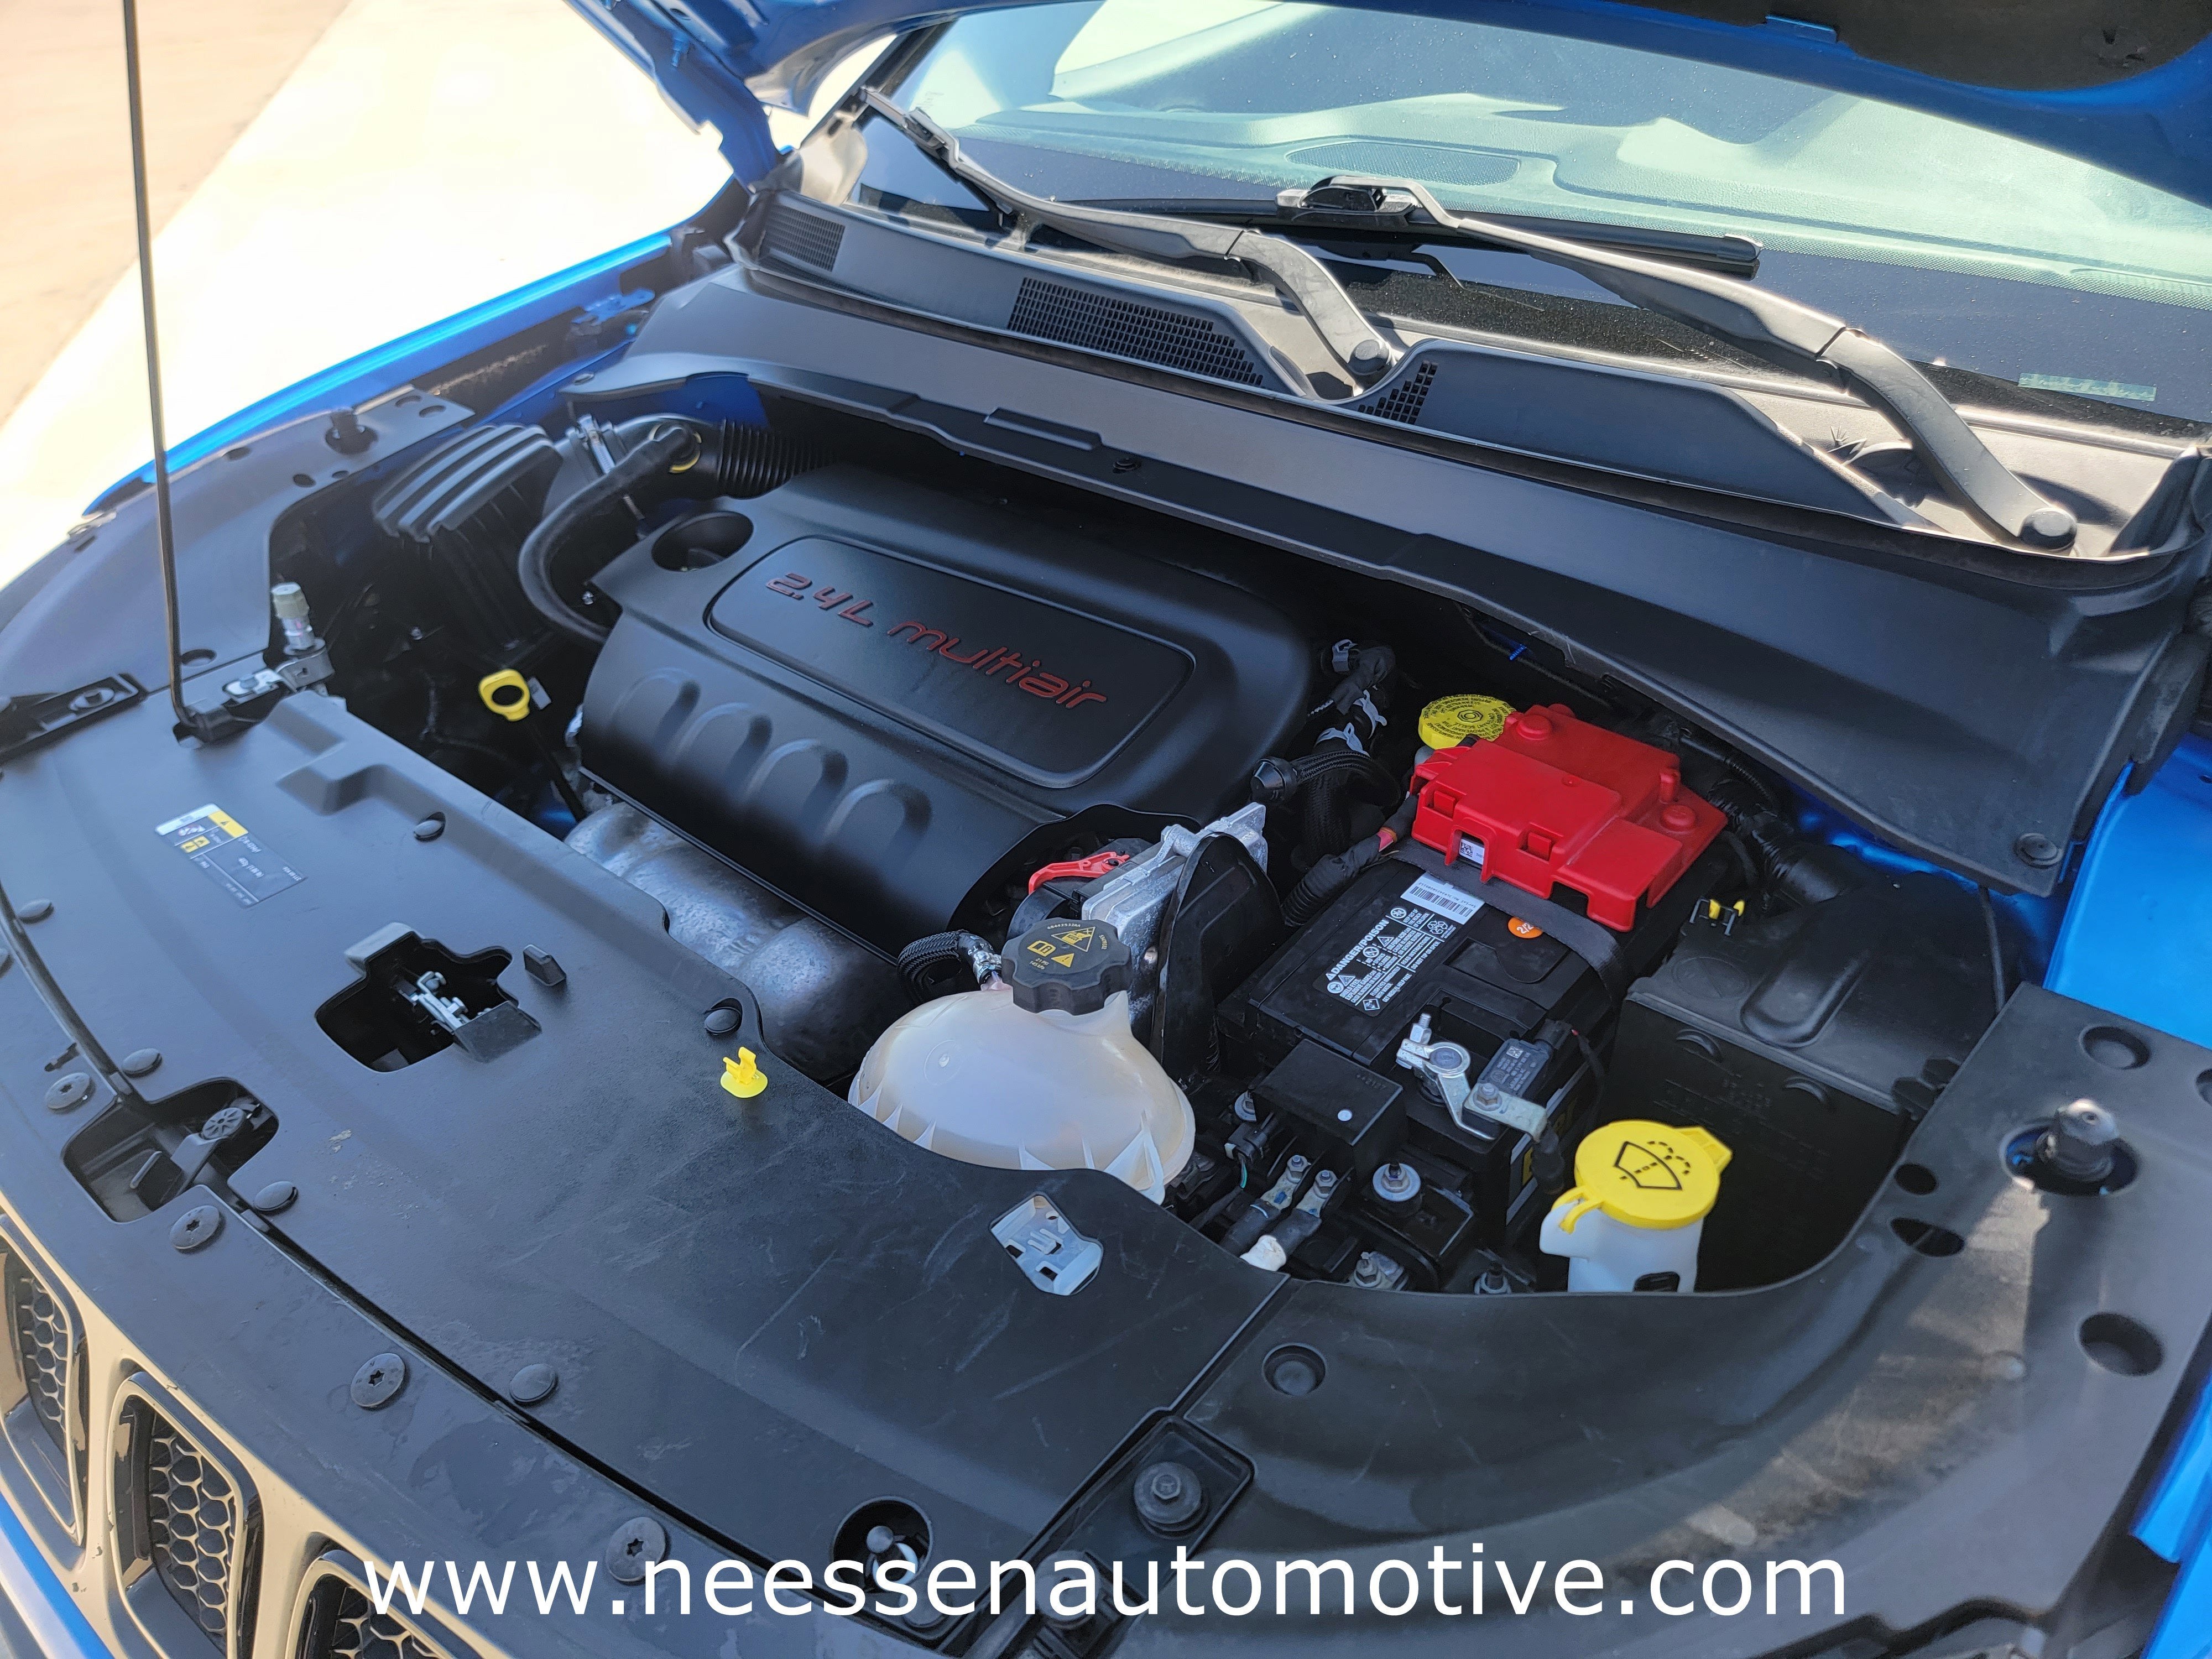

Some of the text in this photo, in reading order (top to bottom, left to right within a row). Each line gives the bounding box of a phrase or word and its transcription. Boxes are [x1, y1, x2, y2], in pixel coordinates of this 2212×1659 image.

[765, 572, 1108, 710] 2.4L multiair
[1330, 919, 1390, 974] DANGER/POISON
[1516, 923, 1534, 934] 2/2
